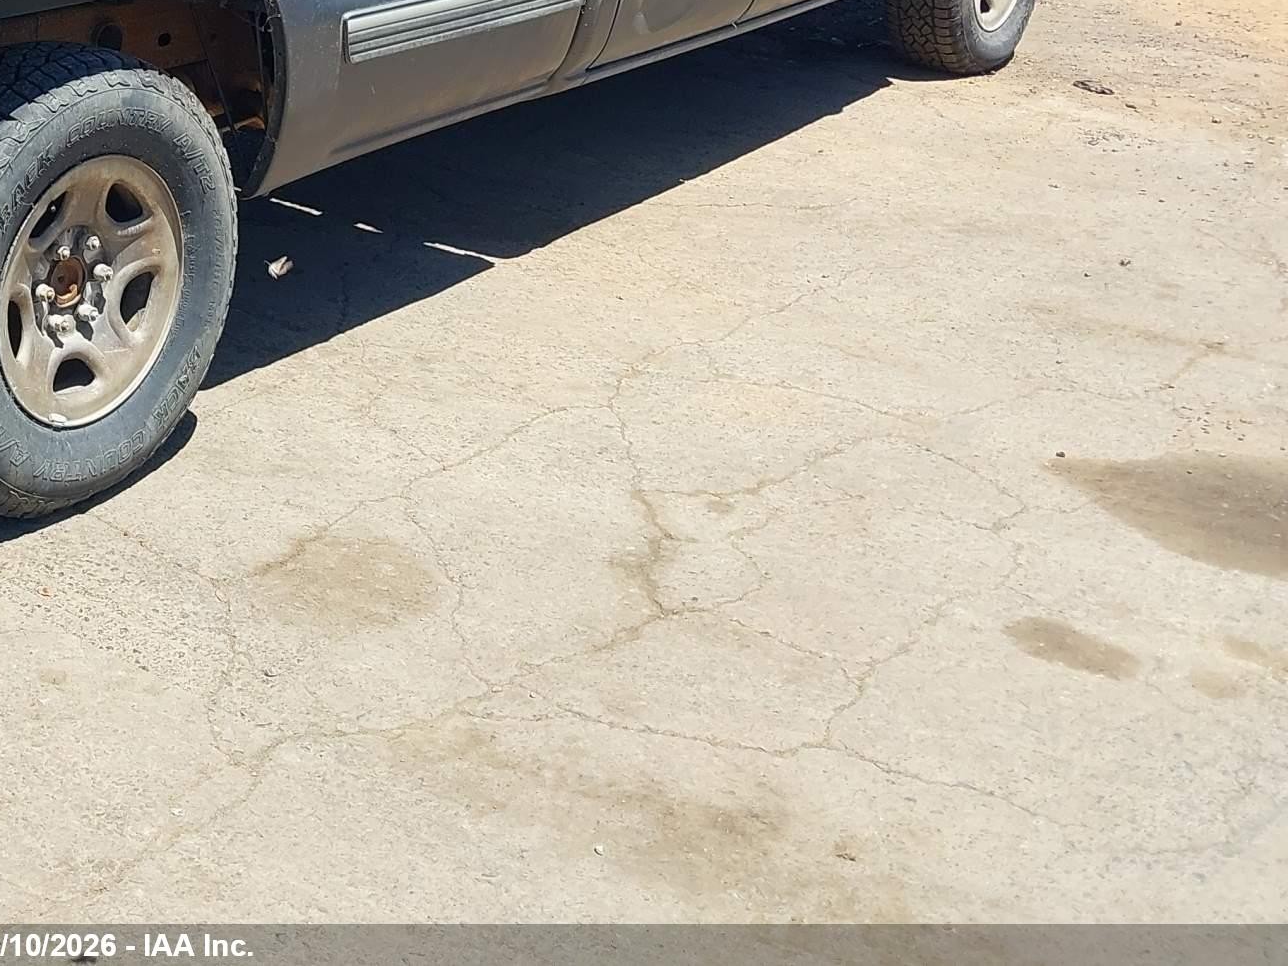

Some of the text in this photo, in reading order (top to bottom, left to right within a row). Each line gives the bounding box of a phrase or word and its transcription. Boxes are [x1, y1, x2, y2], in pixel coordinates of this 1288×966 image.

[66, 107, 173, 148] COUNTRY
[173, 134, 216, 195] A/T2
[32, 428, 147, 483] COUNTRY
